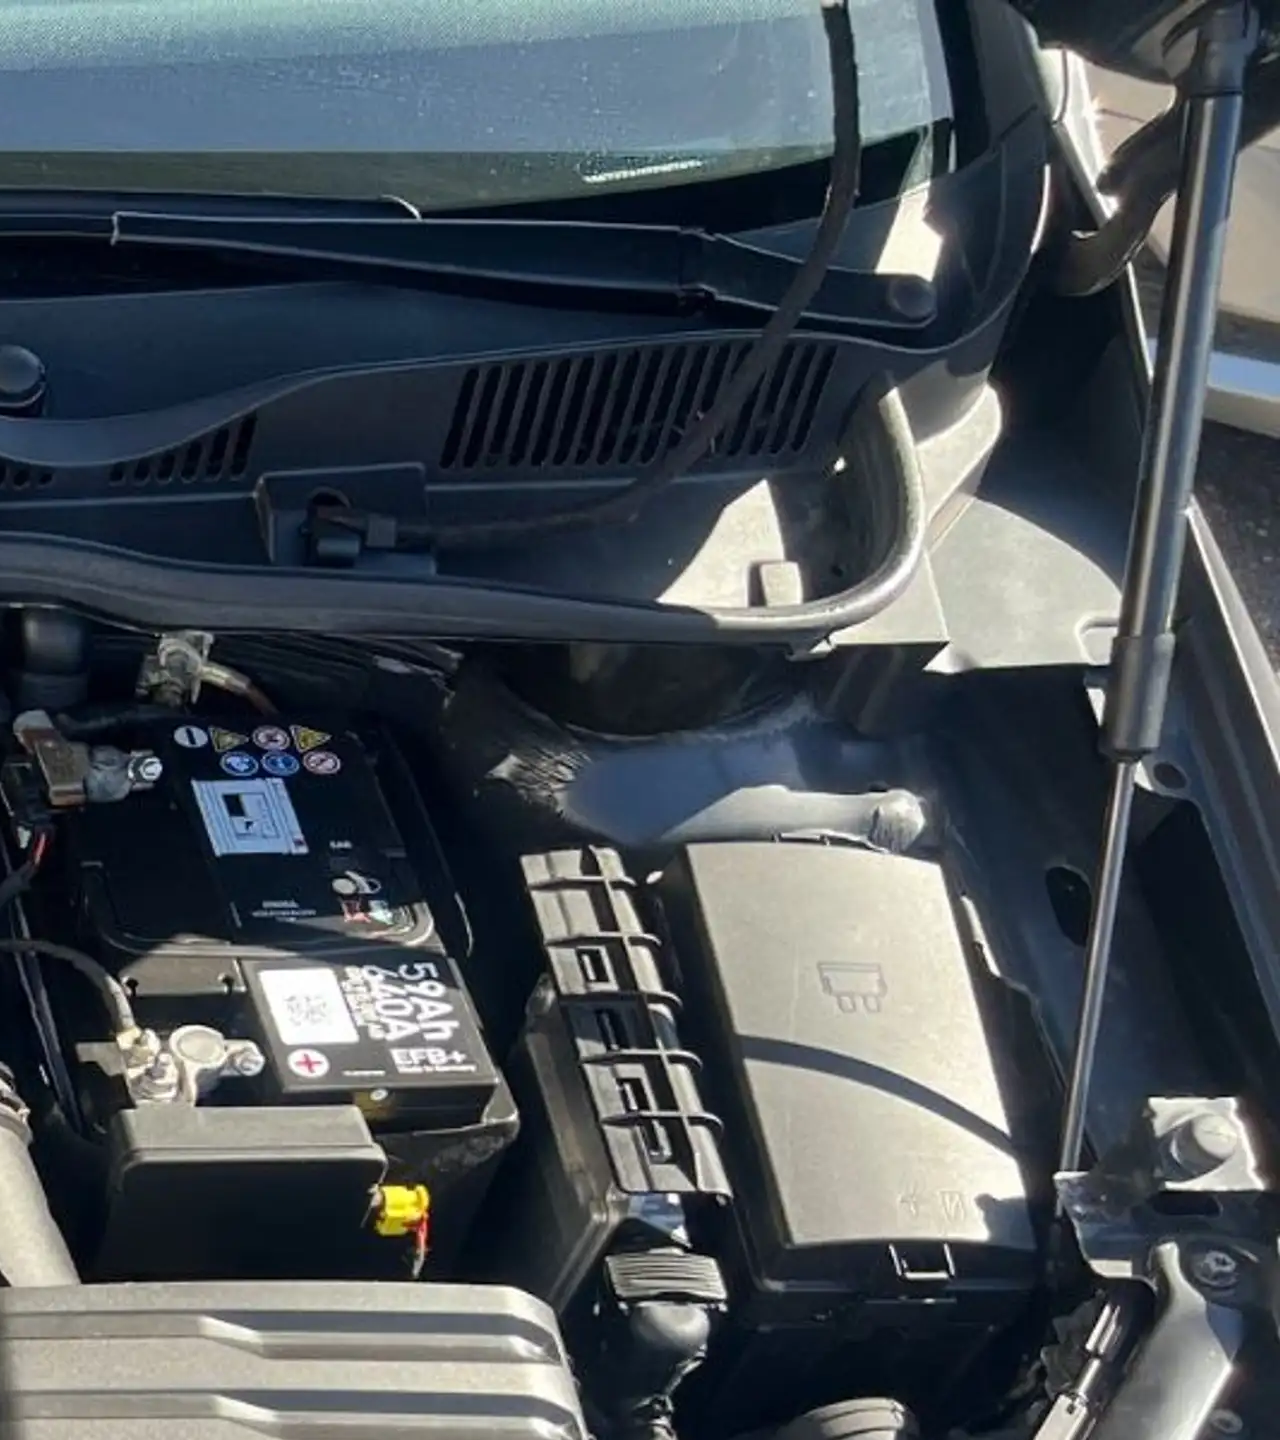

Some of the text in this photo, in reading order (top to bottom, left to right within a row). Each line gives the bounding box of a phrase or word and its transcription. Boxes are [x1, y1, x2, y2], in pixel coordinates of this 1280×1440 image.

[362, 965, 421, 1041] 640A
[398, 962, 460, 1041] 59Ah
[390, 1047, 467, 1065] EFB+
